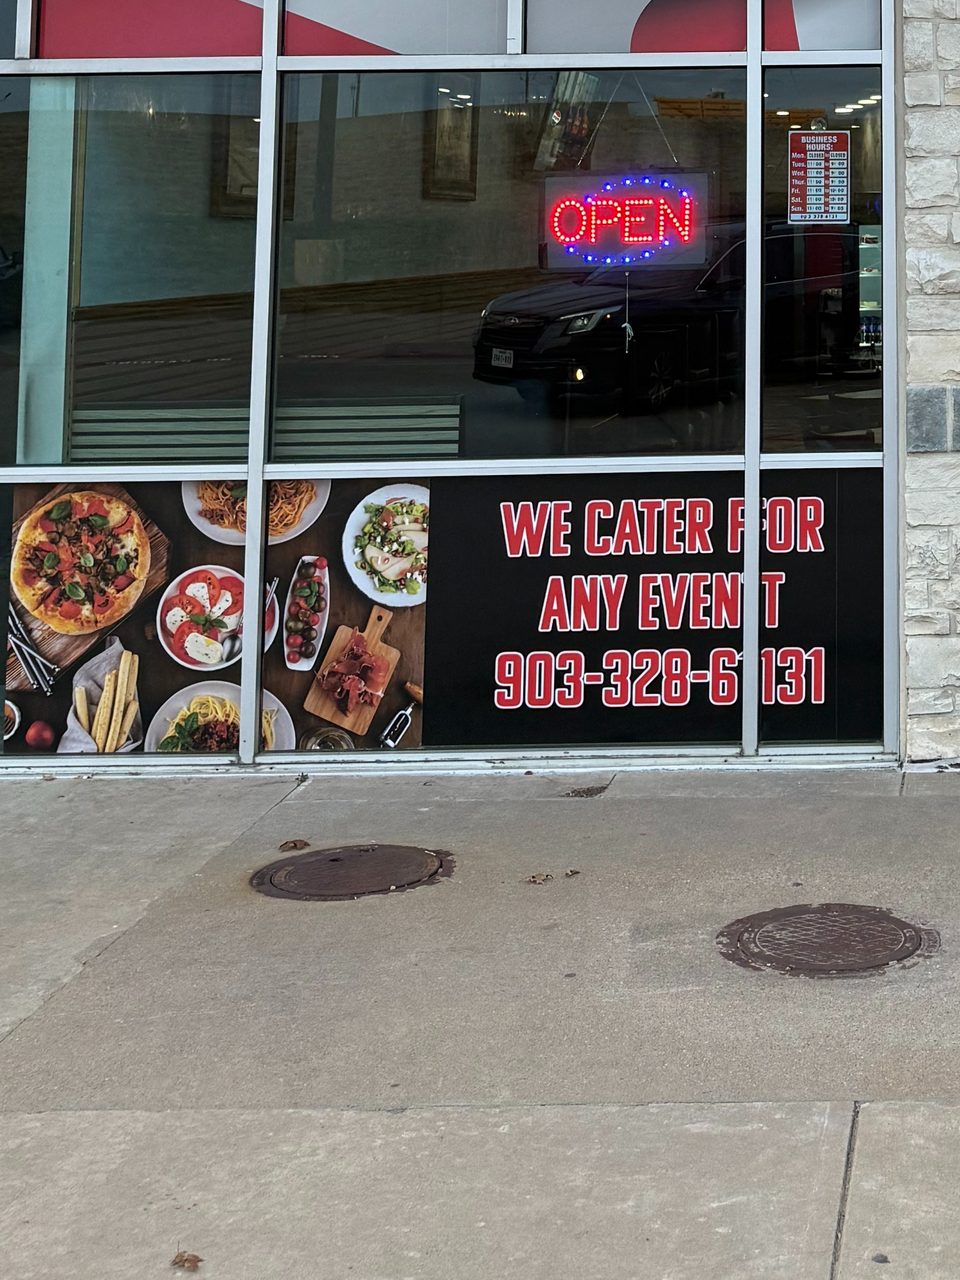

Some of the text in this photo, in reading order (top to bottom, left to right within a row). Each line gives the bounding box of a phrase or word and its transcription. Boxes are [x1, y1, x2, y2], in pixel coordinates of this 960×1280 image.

[552, 197, 693, 244] OPEN
[500, 497, 825, 558] WE CATER FOR
[538, 572, 786, 632] ANY EVENT
[494, 647, 826, 709] 903-328-6131
